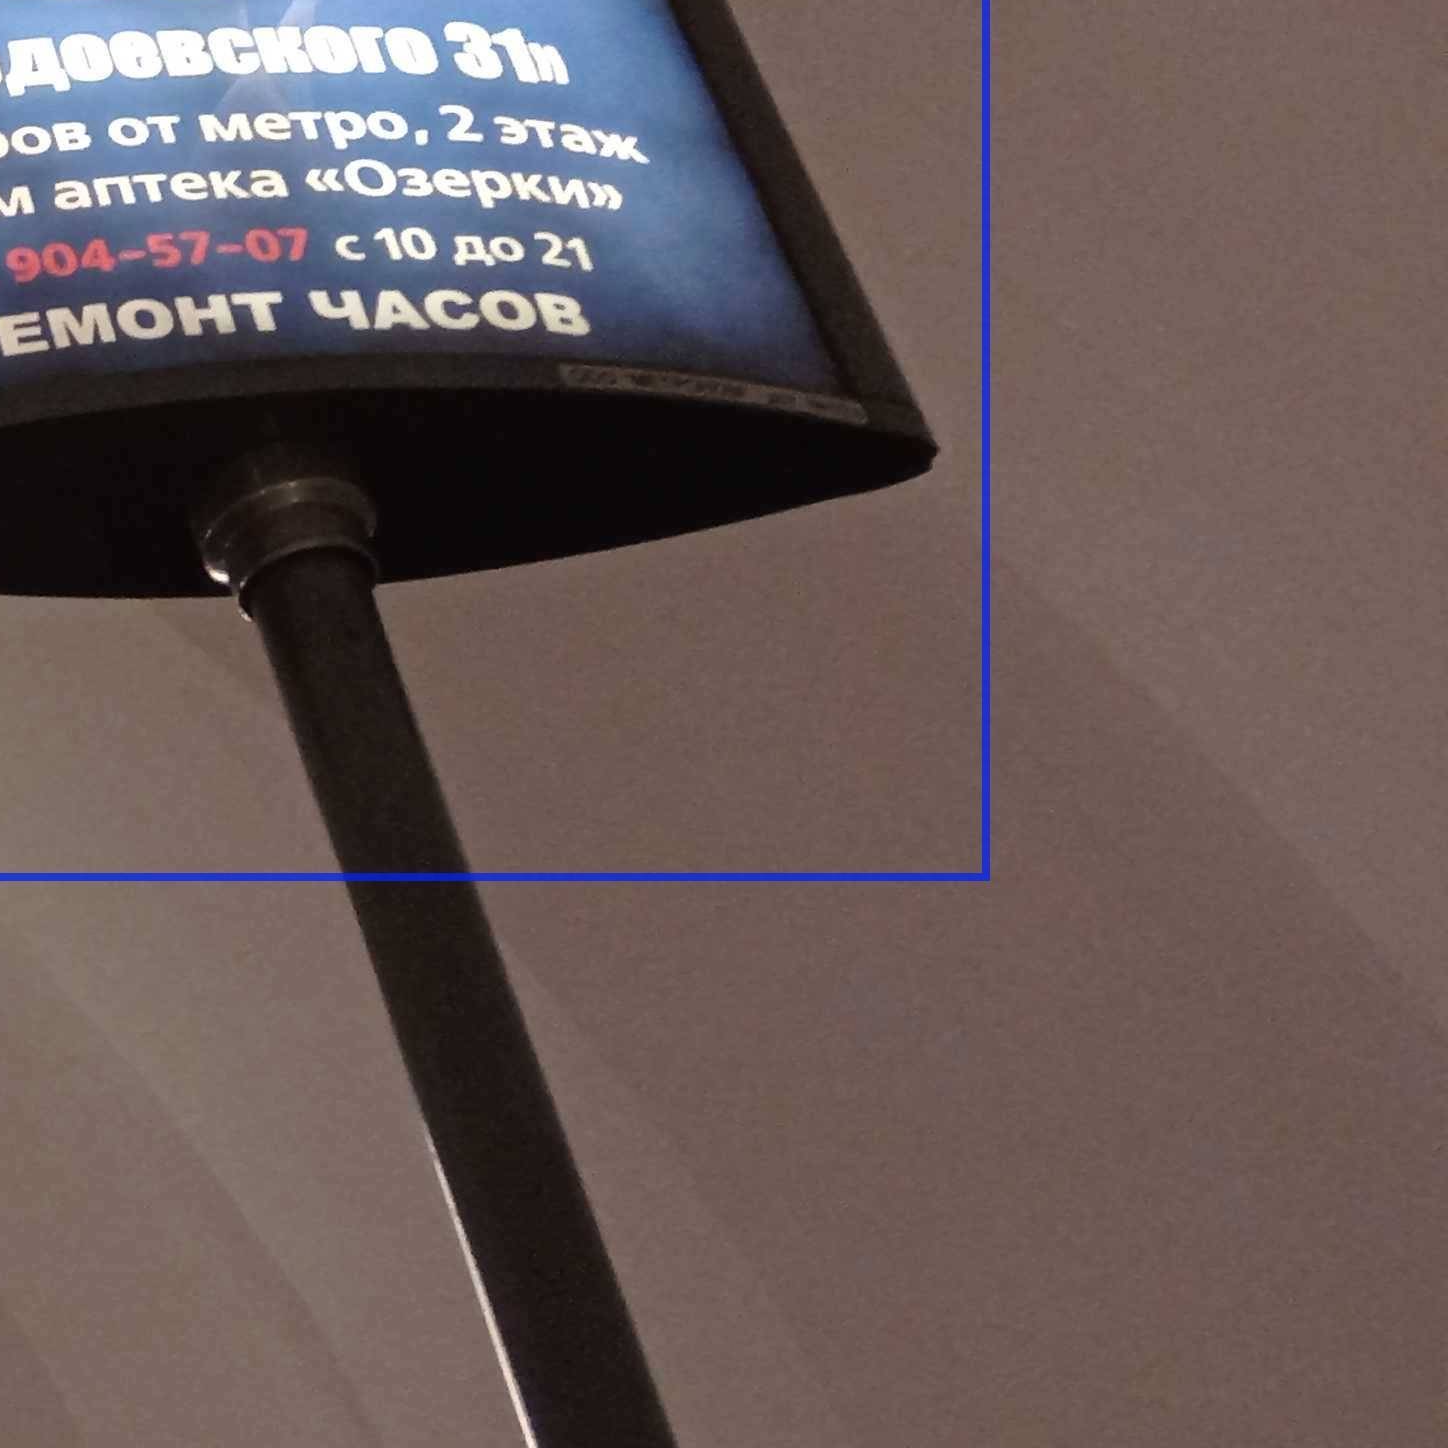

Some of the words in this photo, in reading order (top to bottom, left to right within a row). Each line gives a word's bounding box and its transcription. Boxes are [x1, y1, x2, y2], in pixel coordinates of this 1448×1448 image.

[107, 114, 181, 149] от
[197, 109, 430, 151] метро,
[437, 103, 485, 144] 2
[492, 114, 652, 165] этаж
[52, 169, 290, 212] аптека
[304, 157, 624, 211] «Озерки»
[4, 227, 309, 283] 904-57-07
[334, 233, 367, 261] с
[373, 226, 438, 261] 10
[452, 234, 526, 268] до
[532, 230, 596, 272] 21
[307, 288, 592, 337] ЧАСОВ
